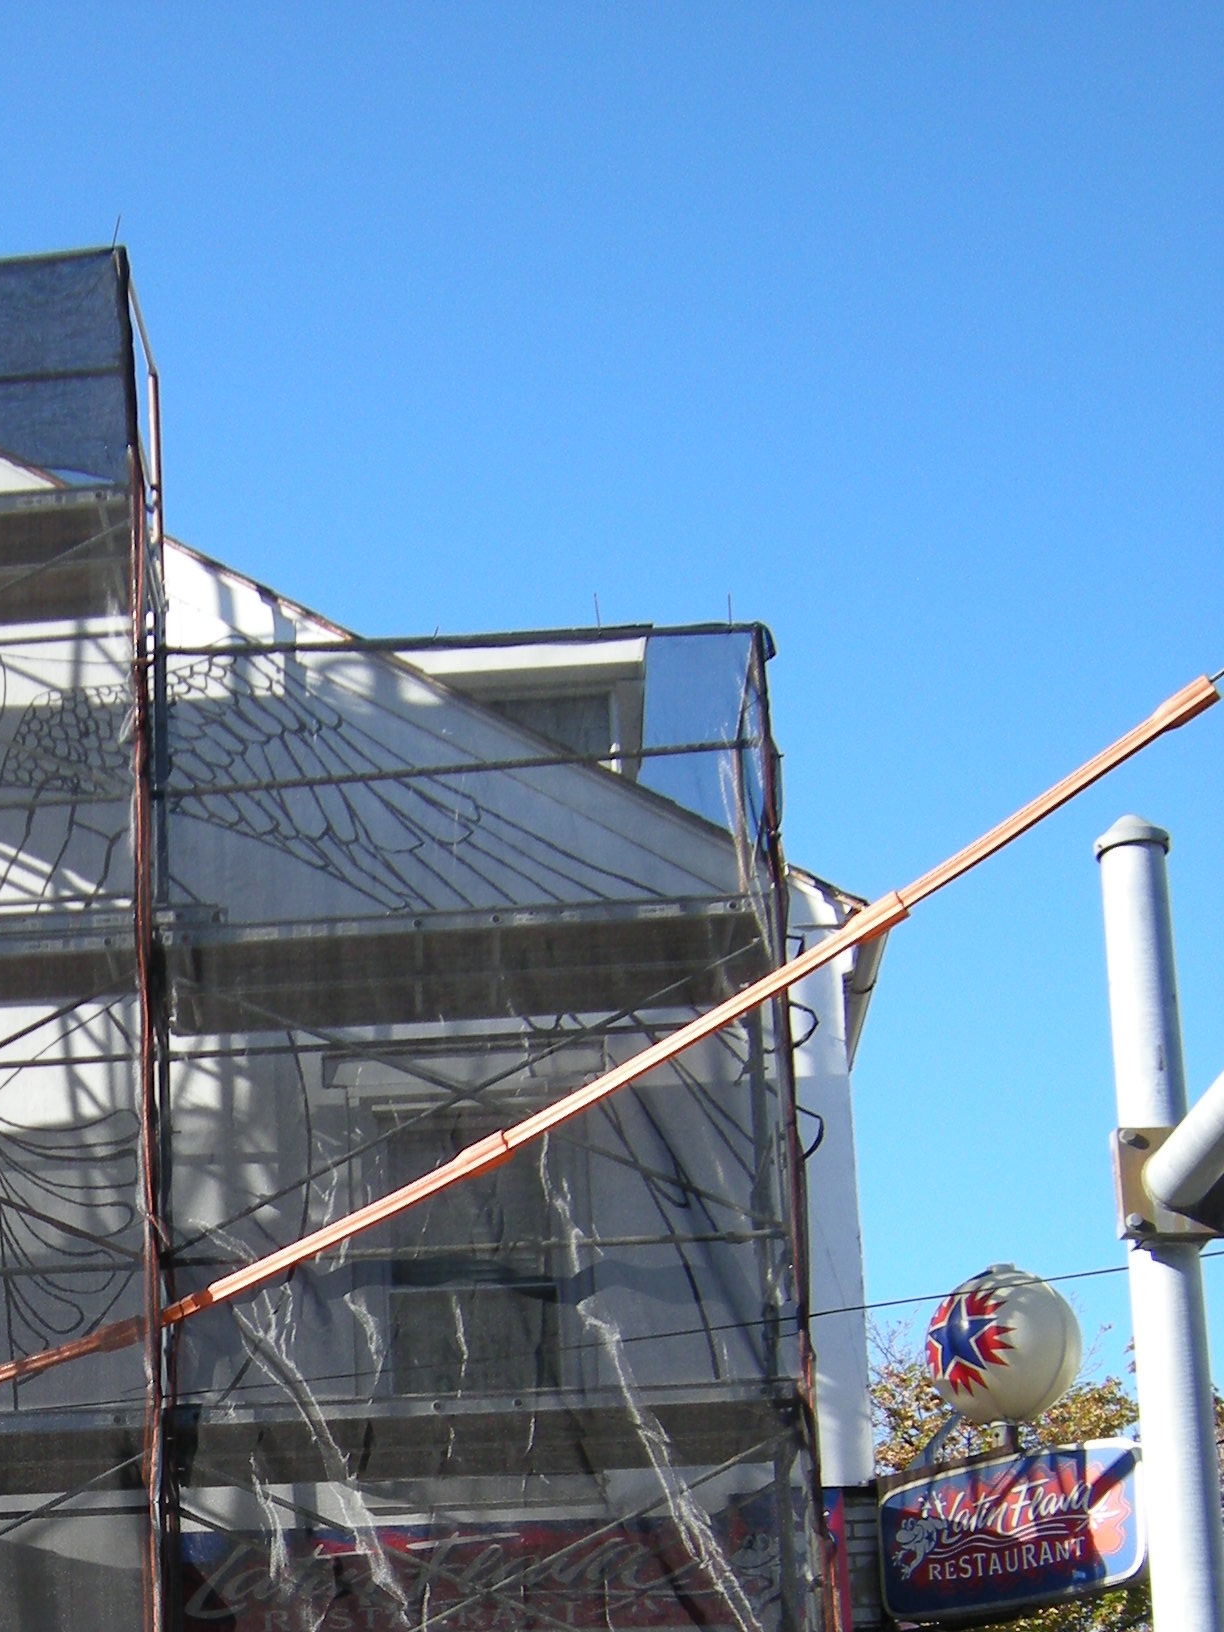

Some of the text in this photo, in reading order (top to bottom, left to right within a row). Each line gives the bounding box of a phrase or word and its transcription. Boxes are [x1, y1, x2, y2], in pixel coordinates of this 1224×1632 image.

[940, 1478, 1096, 1544] Latin Flava
[928, 1536, 1087, 1581] RESTAURANT
